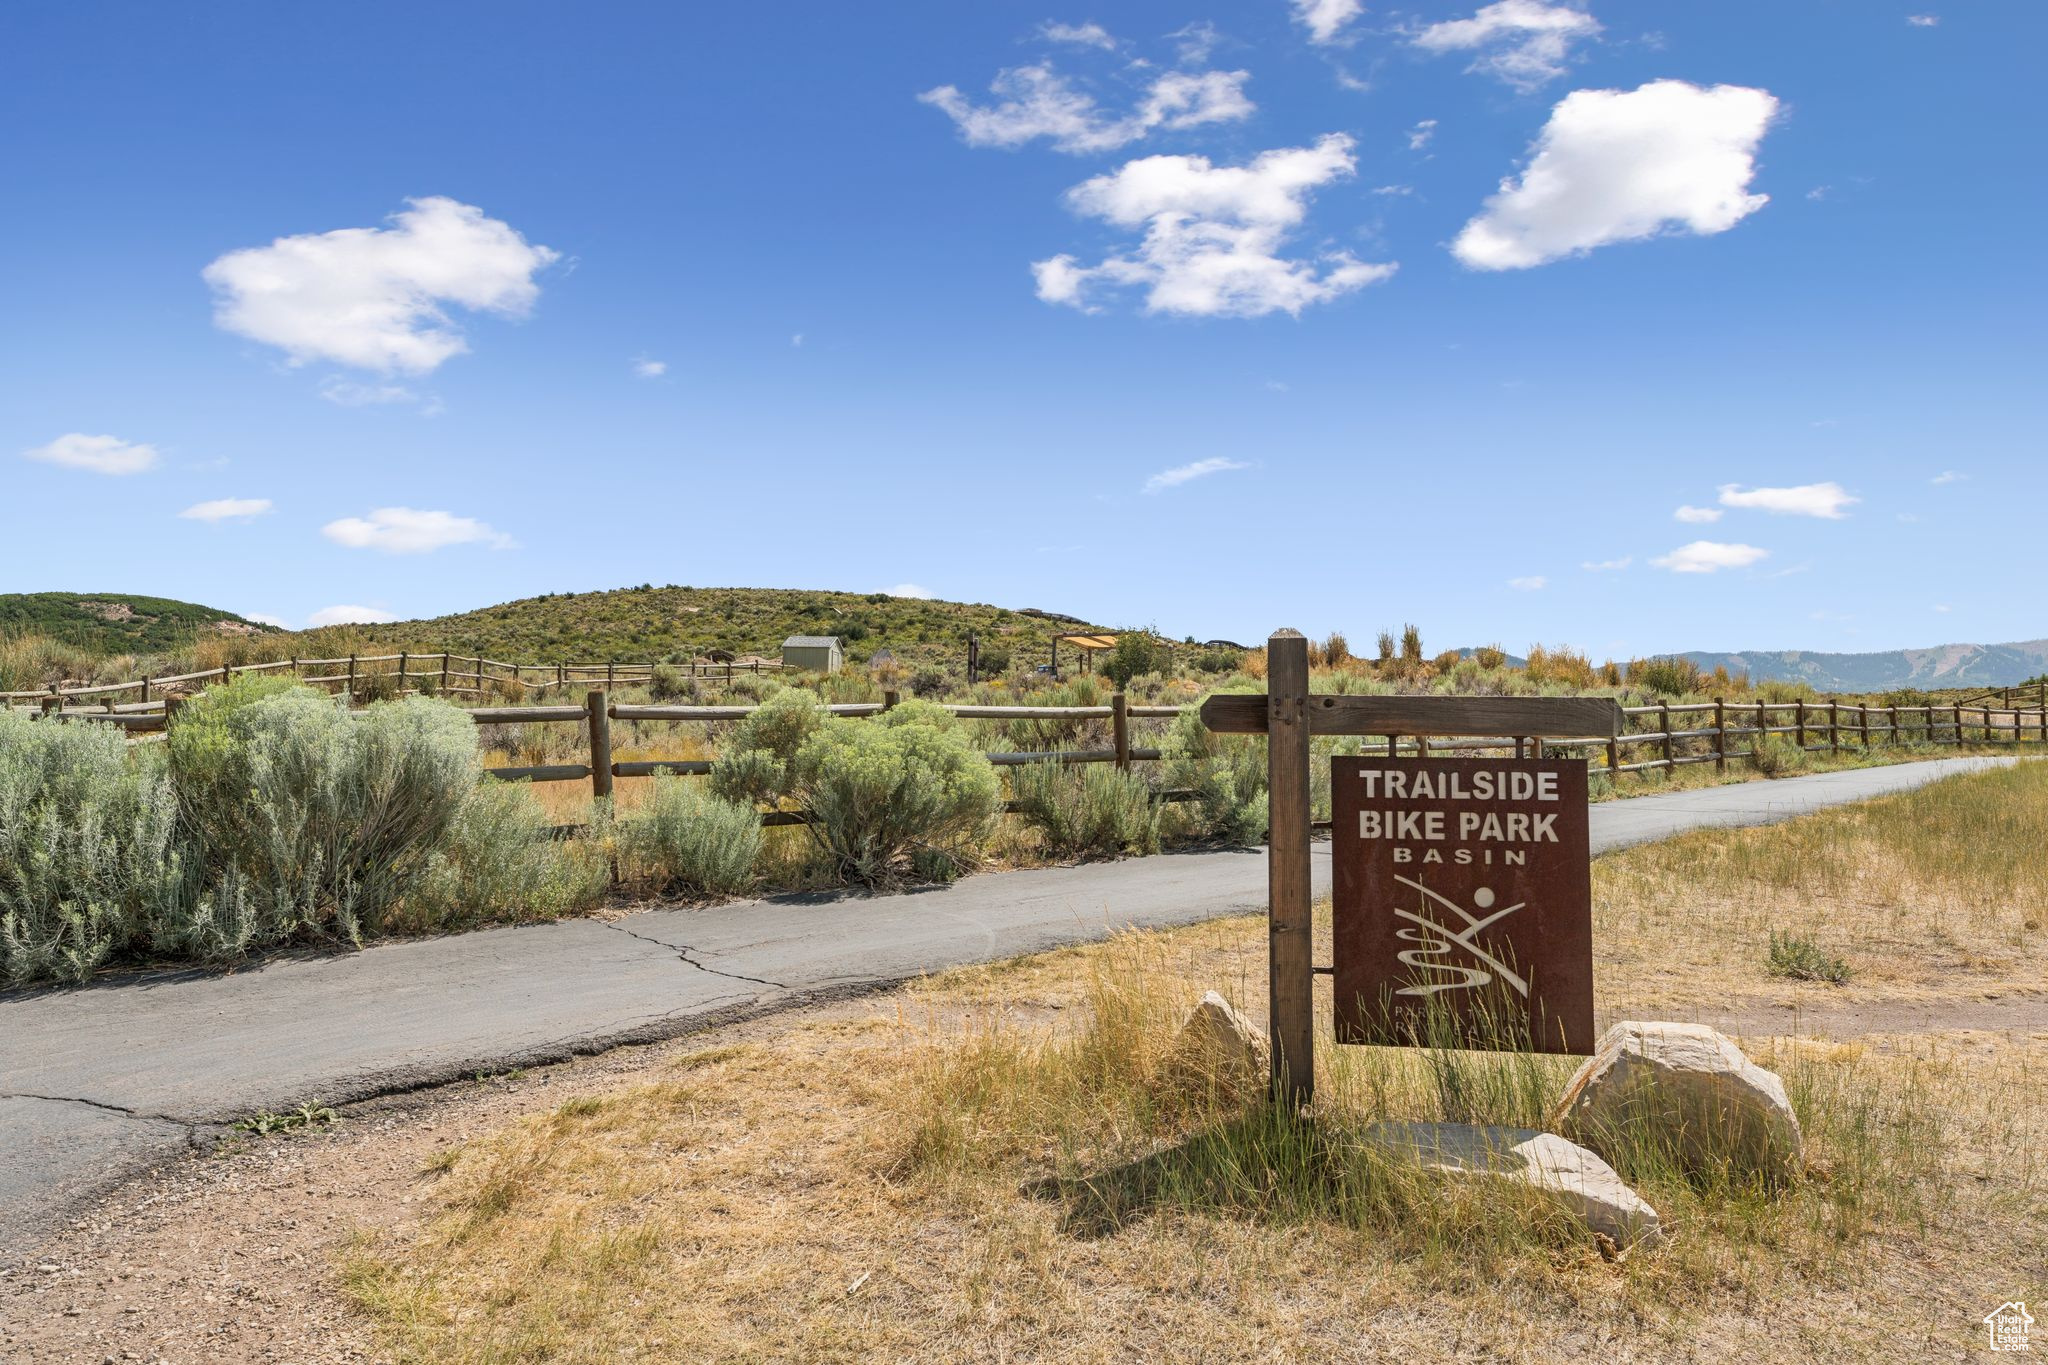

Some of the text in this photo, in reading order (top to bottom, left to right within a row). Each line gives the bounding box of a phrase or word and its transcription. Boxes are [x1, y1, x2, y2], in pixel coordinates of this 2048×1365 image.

[1360, 770, 1559, 801] TRAILSIDE
[1359, 811, 1559, 842] BIKE PARK
[1394, 848, 1526, 865] BASIN
[1395, 1006, 1449, 1019] PARS
